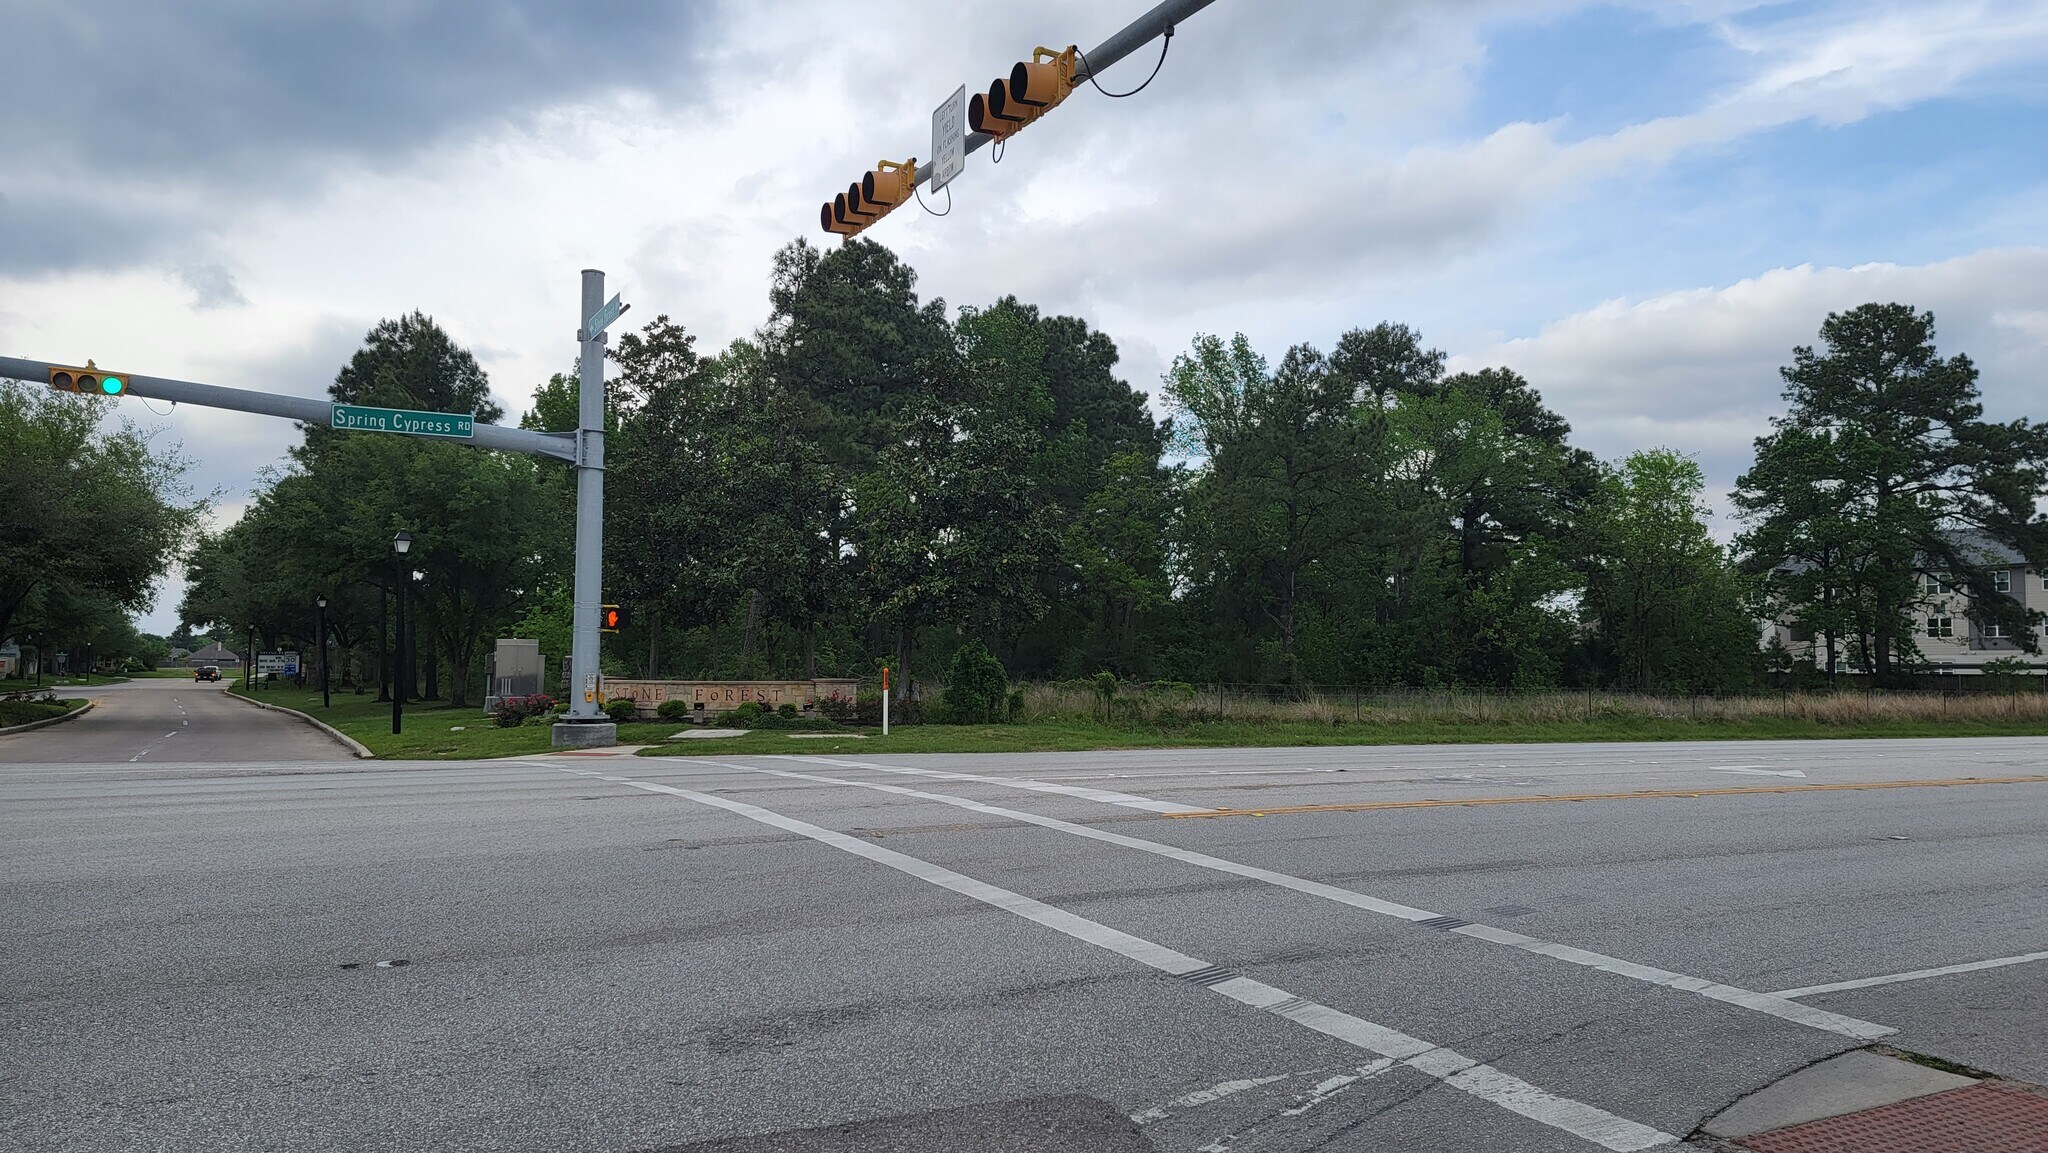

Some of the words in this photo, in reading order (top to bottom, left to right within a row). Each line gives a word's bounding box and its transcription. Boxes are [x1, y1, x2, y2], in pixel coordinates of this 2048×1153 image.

[942, 115, 955, 136] YIELD
[335, 409, 386, 430] Spring
[393, 413, 451, 432] Cypress
[457, 421, 471, 430] RD
[615, 687, 663, 701] STONE
[695, 689, 782, 702] FOREST
